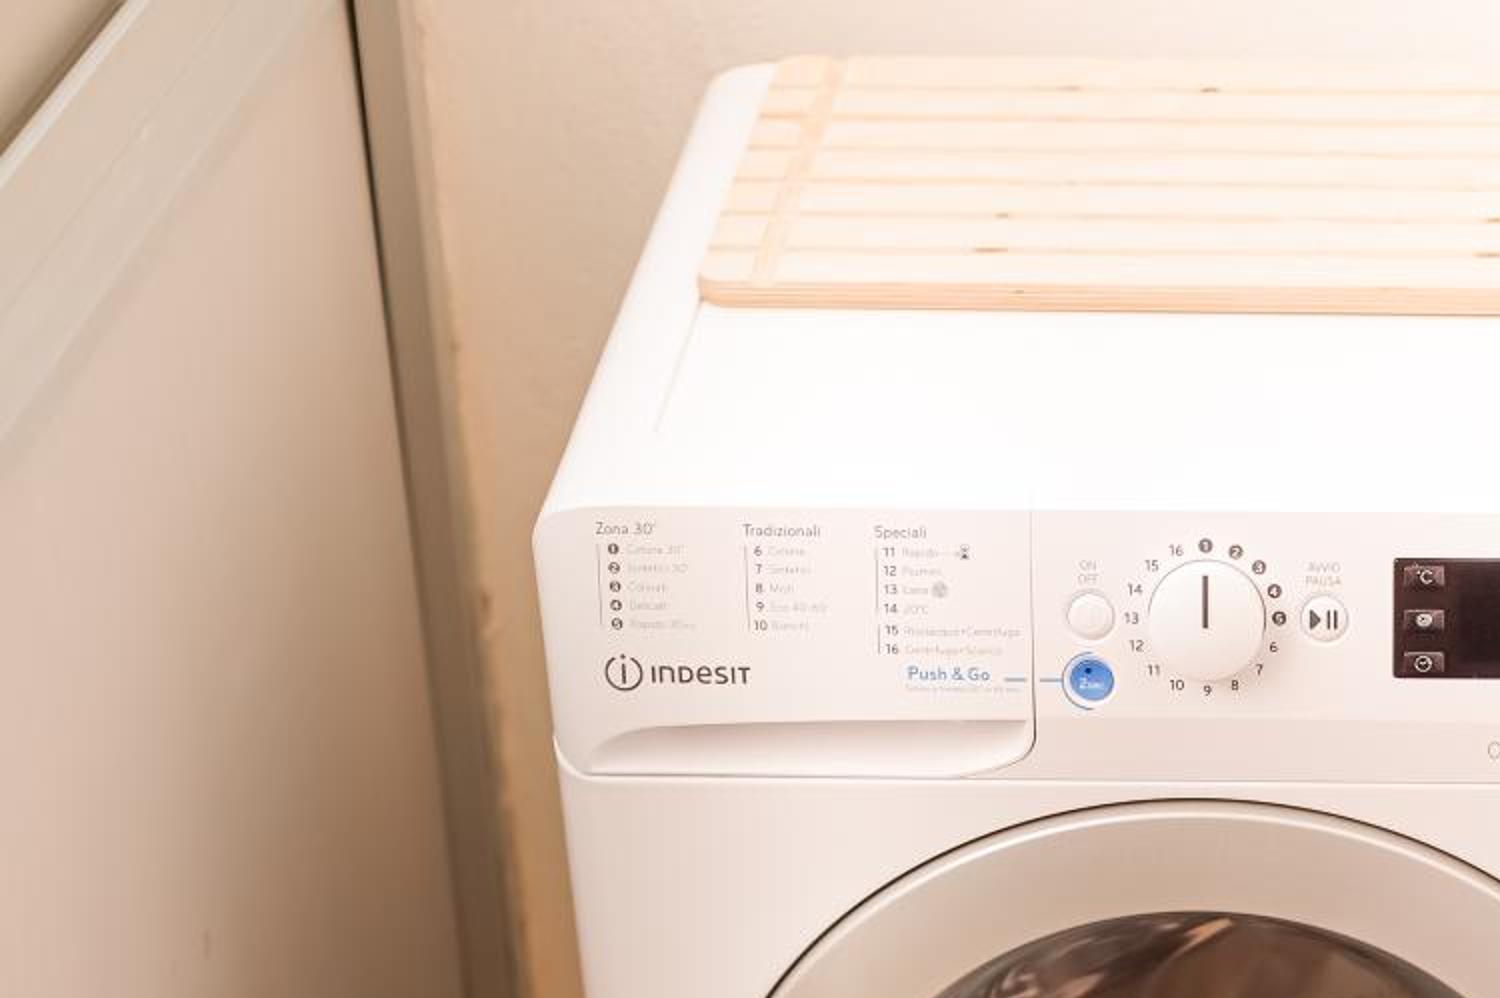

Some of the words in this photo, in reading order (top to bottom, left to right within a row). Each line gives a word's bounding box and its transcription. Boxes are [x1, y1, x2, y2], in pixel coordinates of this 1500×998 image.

[595, 521, 629, 536] Zona
[743, 523, 821, 538] Tradizionali
[873, 525, 927, 540] Speciali
[753, 546, 763, 557] 6
[882, 547, 895, 558] 11
[1169, 544, 1184, 557] 16
[755, 563, 763, 574] 7
[883, 565, 897, 577] 12
[1079, 560, 1097, 571] ON
[1145, 560, 1159, 572] 15
[1078, 573, 1099, 584] OFF
[1306, 574, 1342, 586] PAUSA
[755, 583, 763, 593] 8
[883, 583, 898, 595] 13
[1127, 584, 1143, 596] 14
[755, 601, 765, 612] 9
[883, 603, 898, 614] 14
[1124, 612, 1139, 624] 13
[754, 619, 768, 631] 10
[885, 625, 899, 636] 15
[885, 643, 899, 655] 16
[1129, 640, 1145, 652] 12
[1269, 641, 1279, 653] 6
[907, 666, 947, 681] Push
[951, 666, 965, 681] &
[967, 667, 991, 682] Go
[1147, 664, 1161, 676] 11
[1256, 664, 1264, 676] 7
[1169, 679, 1185, 691] 10
[1203, 685, 1212, 697] 9
[1231, 680, 1240, 692] 8
